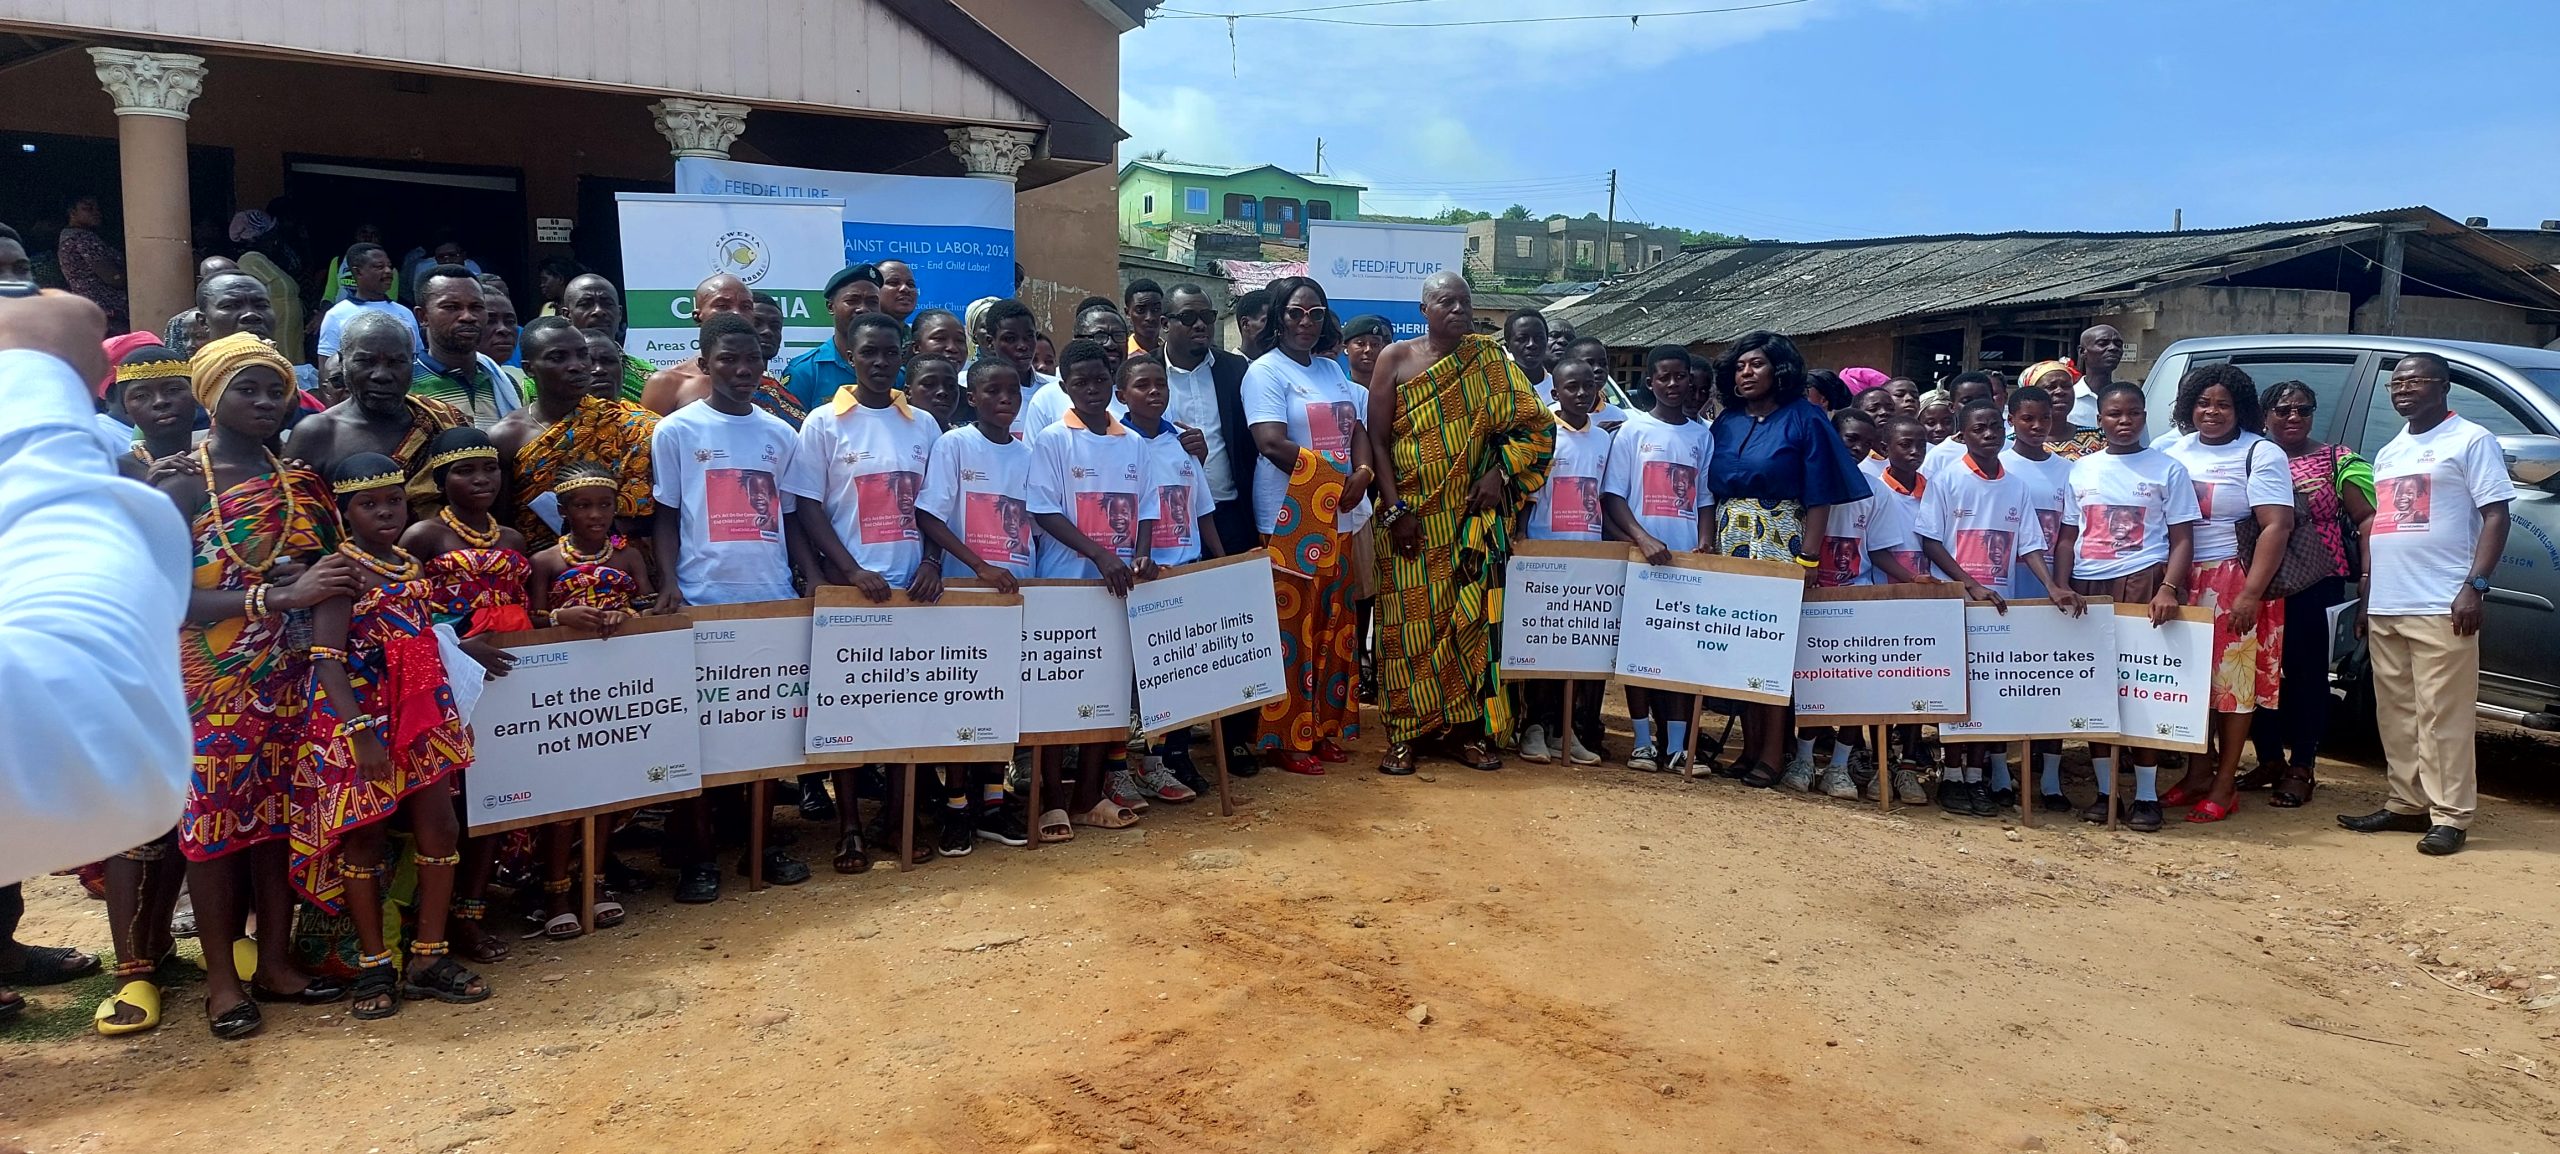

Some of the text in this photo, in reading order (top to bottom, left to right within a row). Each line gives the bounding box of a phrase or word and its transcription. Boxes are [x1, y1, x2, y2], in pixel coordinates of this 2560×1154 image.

[725, 180, 763, 196] FEED
[844, 239, 1009, 257] AINST CHILD LABOR, 2024
[928, 261, 942, 270] End
[946, 261, 965, 271] Child
[968, 263, 990, 272] Labor!
[1352, 260, 1384, 272] FEED
[1389, 261, 1442, 274] FUTURE
[945, 302, 966, 312] Chur
[1391, 323, 1429, 334] SHERIE
[646, 341, 686, 351] Areas
[649, 358, 690, 366] Promot
[770, 356, 784, 364] ish
[2502, 555, 2534, 568] SSION
[1525, 581, 1625, 597] Raise your VOIC
[1546, 600, 1612, 613] and HAND
[1655, 598, 1778, 623] Let's take action
[829, 614, 893, 624] FEED FUTURE
[1522, 616, 1621, 630] so that child lab
[1033, 626, 1097, 644] support
[1147, 612, 1254, 647] Child labor limits
[1645, 616, 1785, 641] against child labor
[1526, 633, 1619, 646] can be BANNE
[1697, 639, 1729, 652] now
[1807, 635, 1936, 650] Stop children from
[836, 646, 988, 663] Child labor limits
[1043, 646, 1102, 664] against
[1152, 655, 1160, 667] a
[1202, 635, 1238, 654] ability
[1242, 631, 1254, 644] to
[525, 652, 569, 665] FUTURE
[1822, 651, 1922, 665] working under
[1968, 650, 2095, 664] Child labor takes
[2119, 653, 2182, 667] must be
[695, 663, 809, 681] Children nee
[1037, 667, 1084, 681] Labor
[1139, 646, 1272, 690] experience education
[1638, 665, 1661, 674] USAID
[1793, 666, 1951, 681] exploitative conditions
[1995, 668, 2074, 680] innocence
[2079, 666, 2096, 679] of
[845, 673, 855, 684] a
[926, 667, 978, 684] ability
[2136, 669, 2178, 687] learn,
[531, 678, 654, 708] Let the child
[697, 687, 730, 704] VE
[736, 684, 770, 701] and
[816, 686, 1005, 708] to experience growth
[1999, 685, 2061, 697] children
[2134, 686, 2148, 699] to
[2153, 691, 2188, 703] earn
[494, 719, 540, 737] earn
[548, 697, 688, 730] KNOWLEDGE,
[718, 708, 767, 724] labor
[771, 706, 786, 720] is
[1151, 711, 1171, 722] USAID
[537, 723, 652, 755] not MONEY
[825, 735, 853, 744] USAID
[498, 791, 532, 803] USAID
